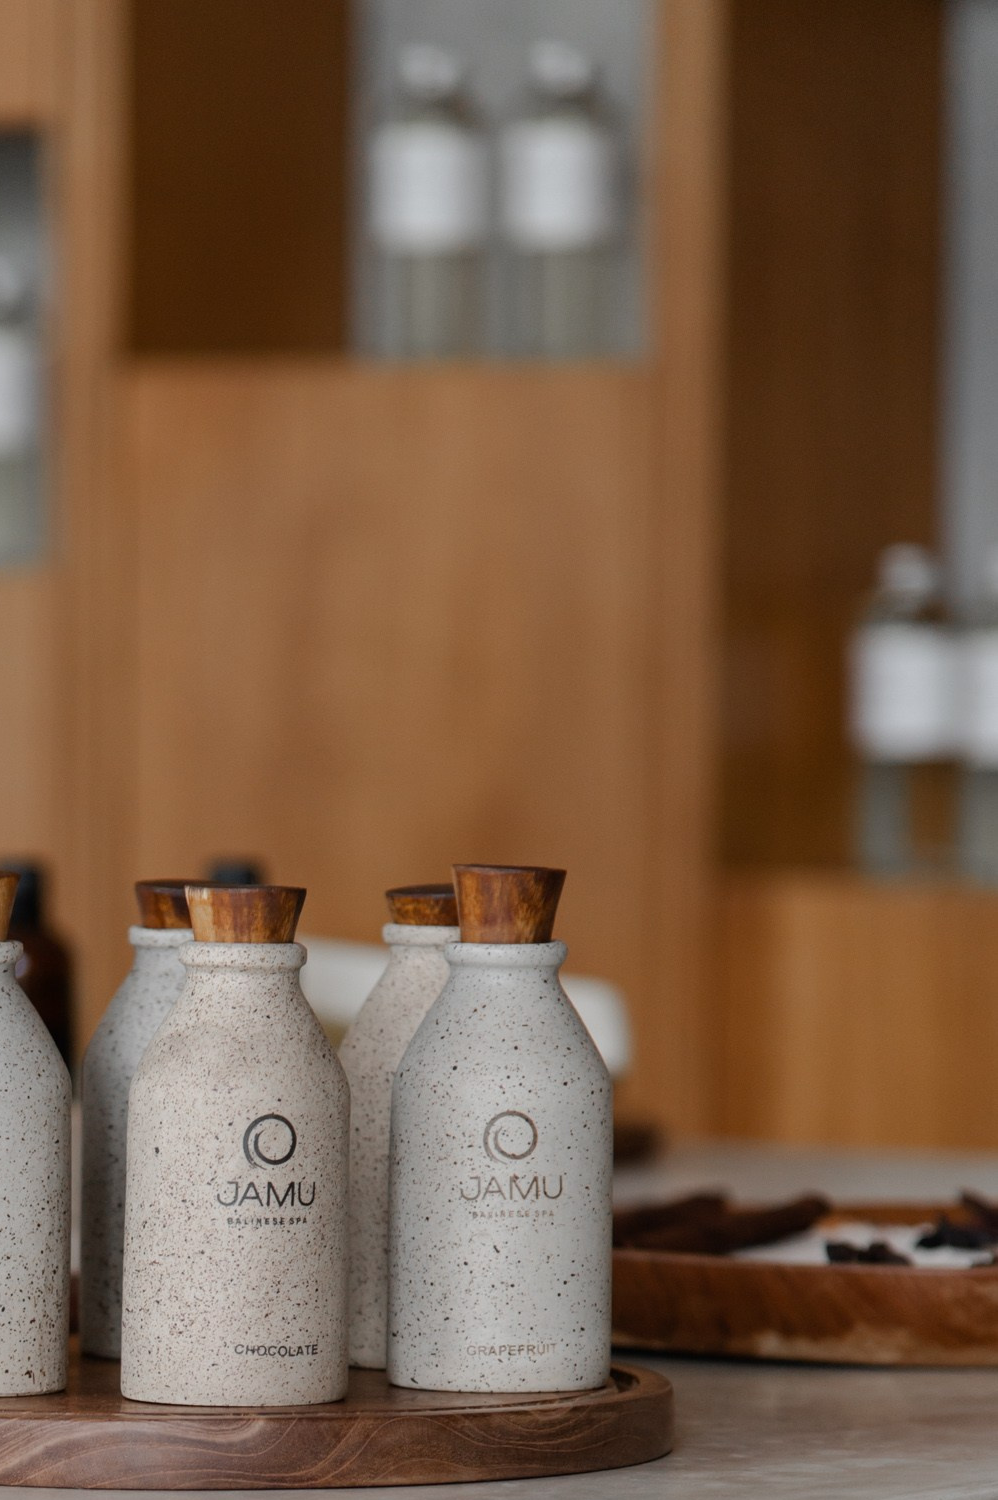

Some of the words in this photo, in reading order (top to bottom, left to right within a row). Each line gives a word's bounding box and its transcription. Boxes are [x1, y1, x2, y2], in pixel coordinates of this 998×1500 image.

[216, 1181, 316, 1207] JAMU
[460, 1174, 563, 1201] JAMU
[227, 1217, 285, 1226] BALINESE
[289, 1216, 308, 1226] SPA
[472, 1209, 530, 1219] BALINESE
[534, 1209, 555, 1218] SPA
[234, 1343, 319, 1357] CHOCOLATE
[466, 1342, 558, 1356] GRAPEFRUIT
